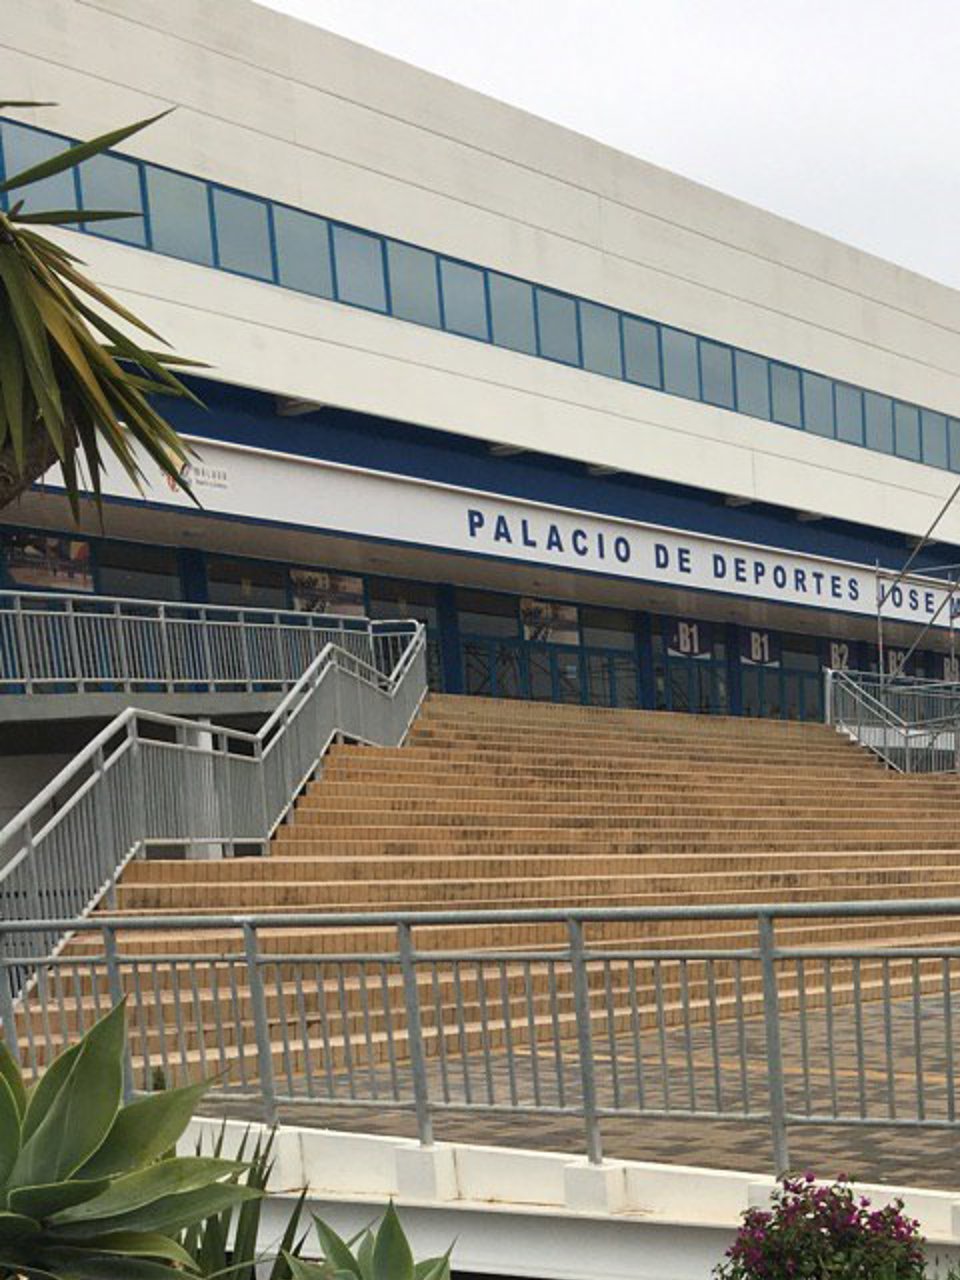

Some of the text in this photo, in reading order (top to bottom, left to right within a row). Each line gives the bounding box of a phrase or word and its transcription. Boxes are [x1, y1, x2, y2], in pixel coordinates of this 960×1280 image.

[467, 509, 631, 563] PALACIO
[655, 544, 691, 573] DE
[713, 554, 860, 600] DEPORTES
[877, 584, 934, 613] JOSE
[678, 622, 699, 653] B1
[751, 632, 769, 662] B1
